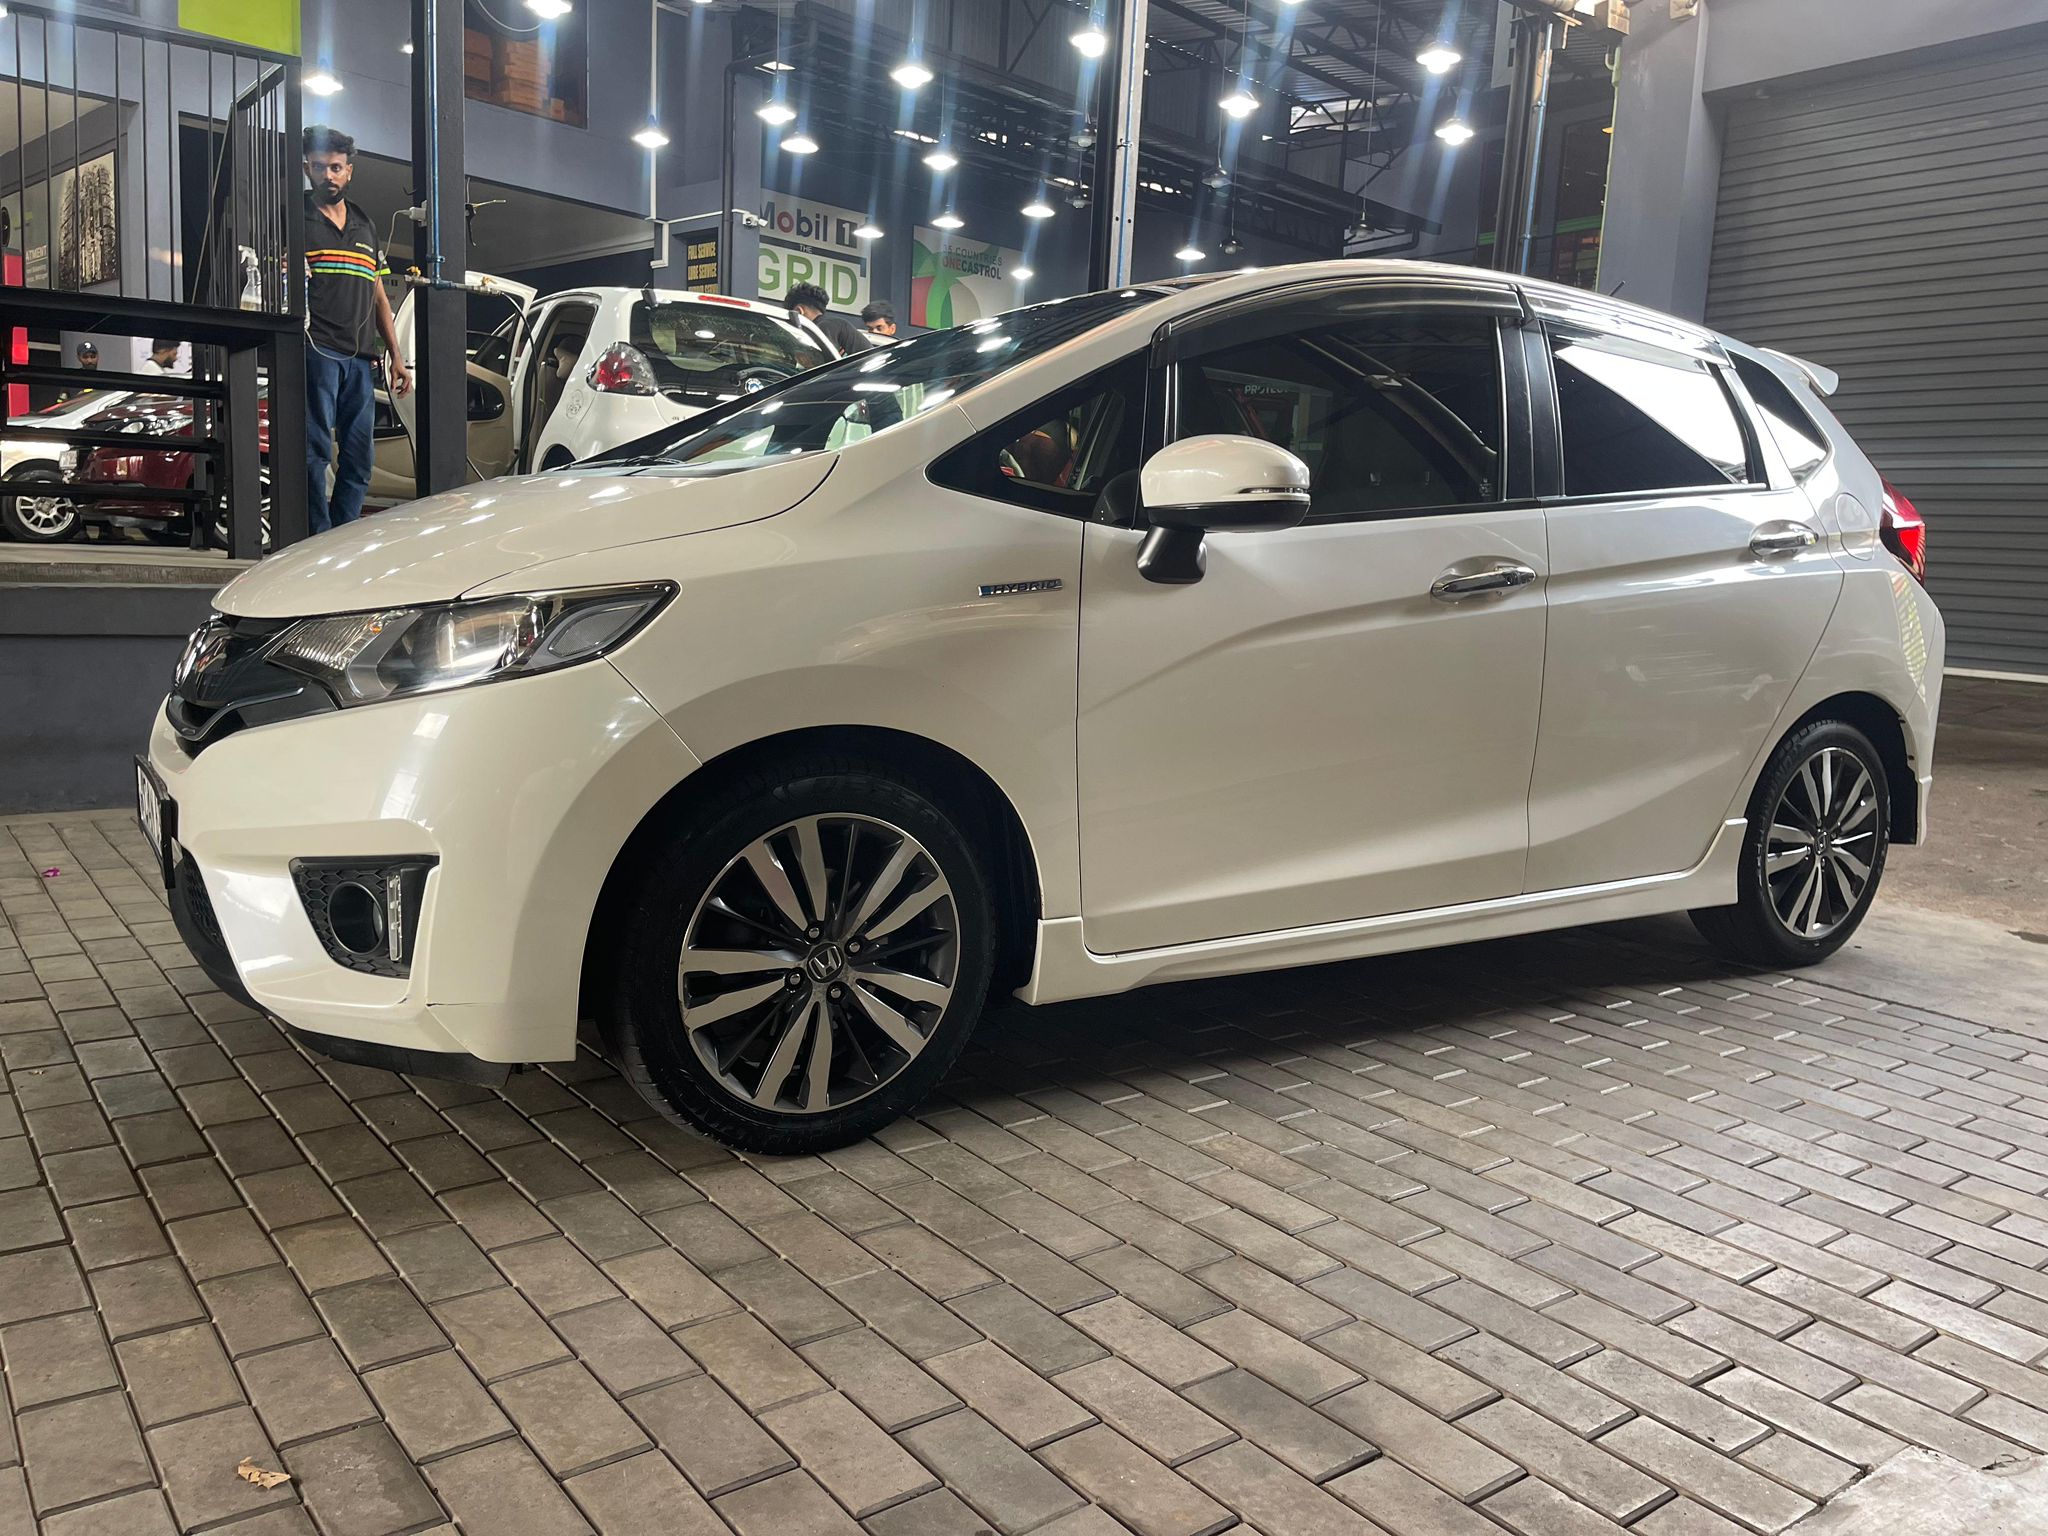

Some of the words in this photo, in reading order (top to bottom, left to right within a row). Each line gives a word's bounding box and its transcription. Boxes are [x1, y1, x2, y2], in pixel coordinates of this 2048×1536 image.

[760, 201, 828, 241] Mobil
[698, 242, 716, 259] SERVICE
[800, 245, 813, 254] THE
[956, 247, 1003, 266] COUNTRIES
[699, 263, 717, 279] SERVICE
[758, 248, 858, 305] GRID
